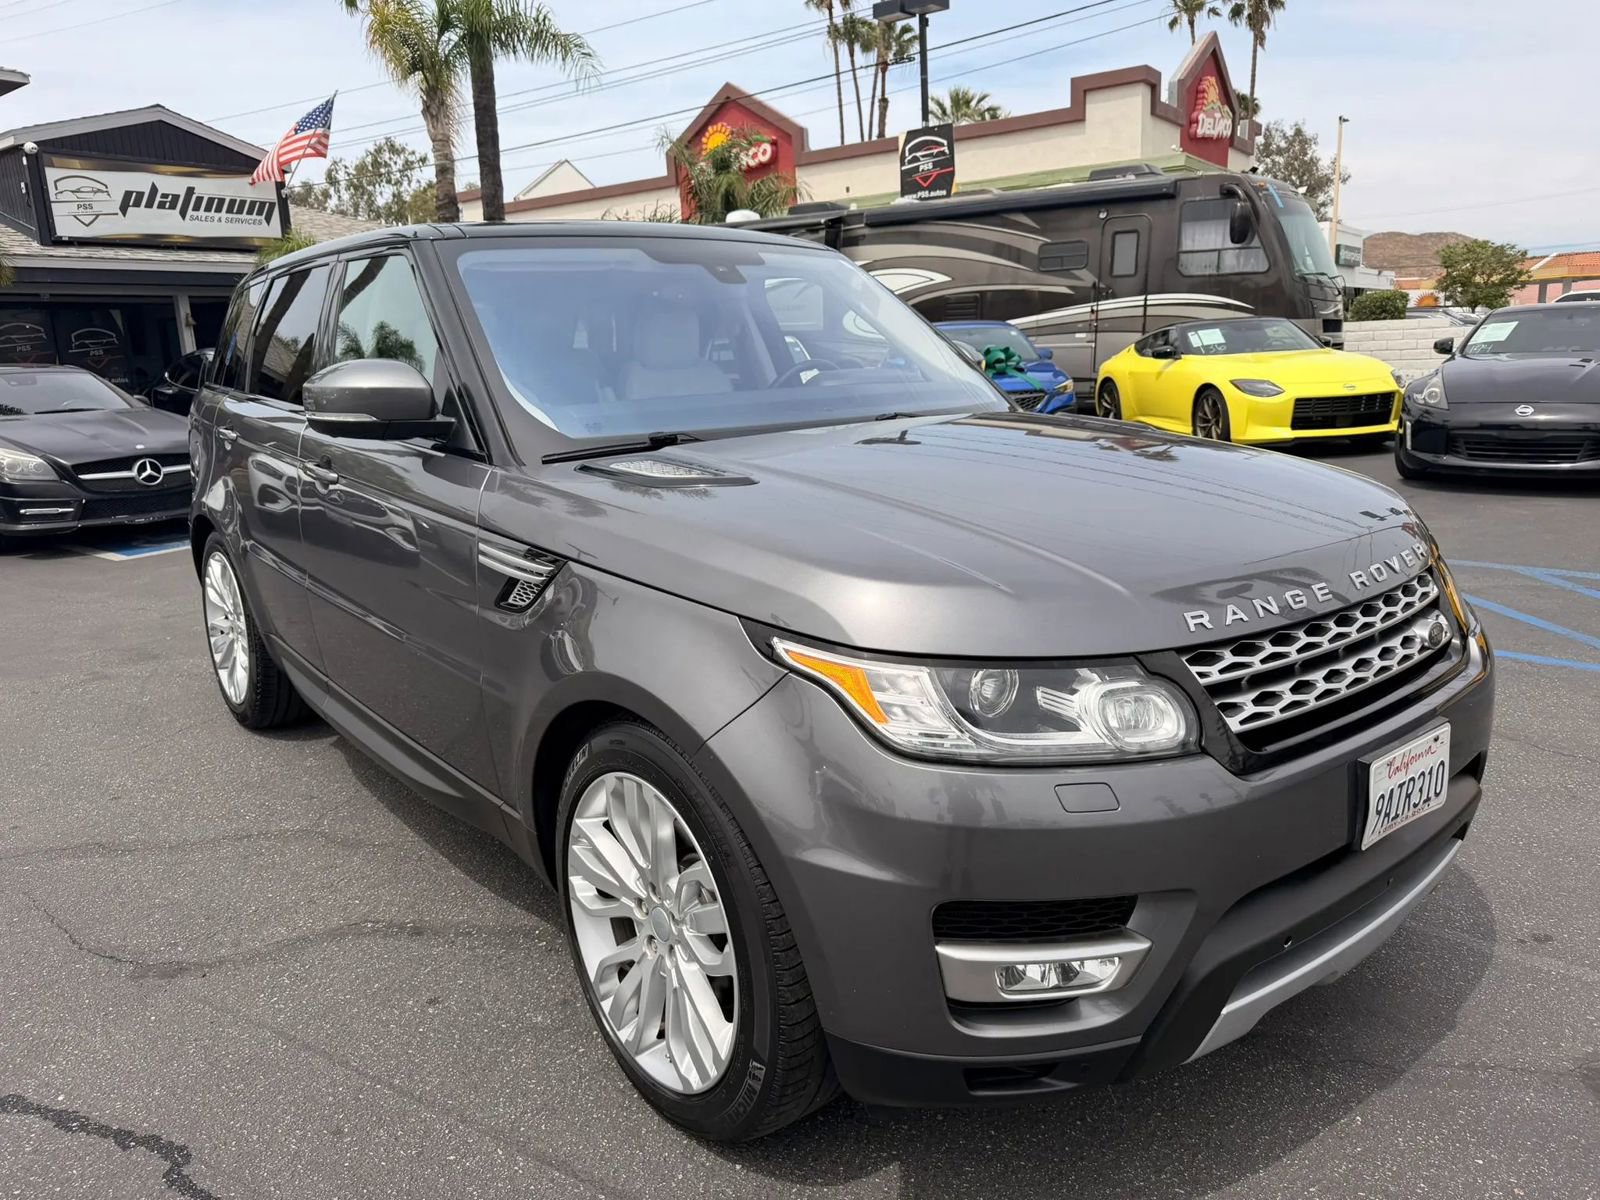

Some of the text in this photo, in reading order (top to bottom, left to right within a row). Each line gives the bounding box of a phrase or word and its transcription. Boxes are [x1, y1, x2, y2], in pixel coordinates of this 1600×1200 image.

[919, 162, 933, 171] PSS
[119, 181, 276, 226] platinum
[189, 214, 215, 222] SALES
[224, 217, 263, 225] SERVICES
[1183, 542, 1427, 632] RANGE ROVER
[1386, 744, 1437, 779] California
[1371, 759, 1445, 836] 9AIR310
